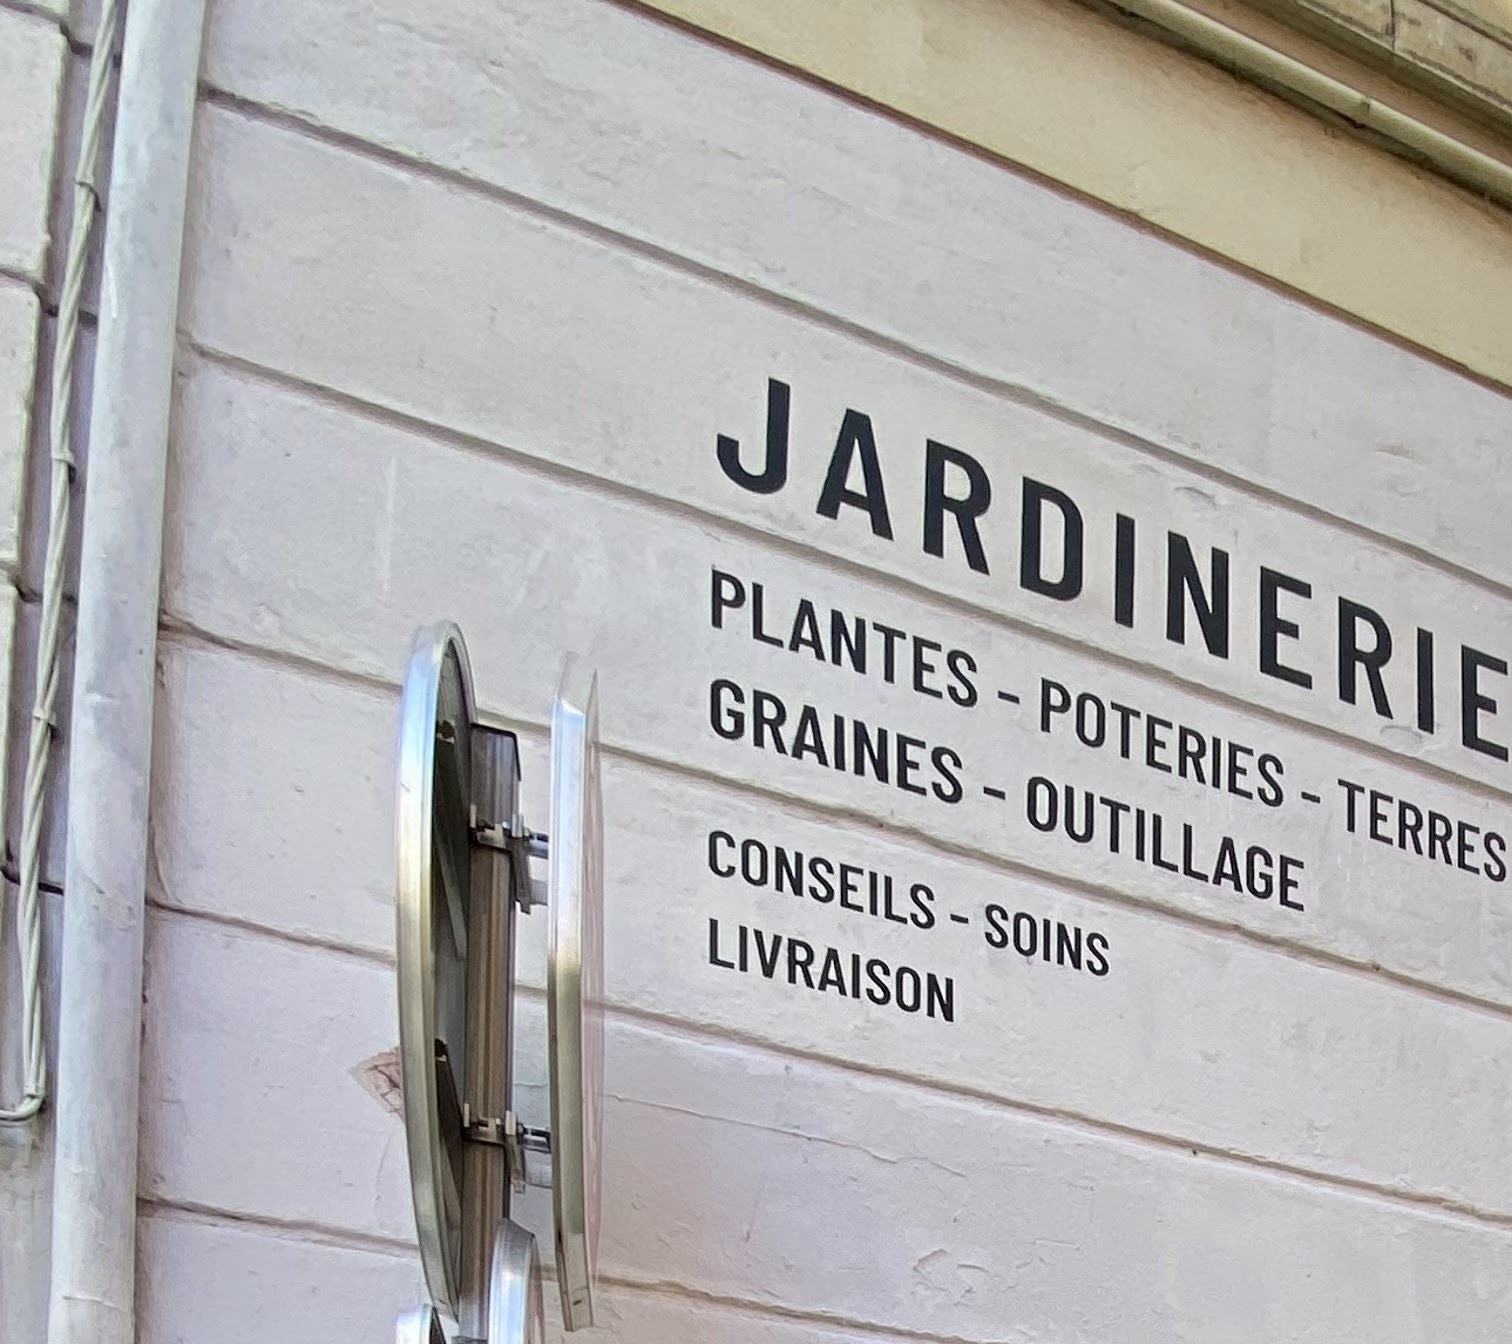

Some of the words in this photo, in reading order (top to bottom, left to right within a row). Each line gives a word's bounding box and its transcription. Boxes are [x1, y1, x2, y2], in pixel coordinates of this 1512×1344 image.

[715, 376, 1510, 763] JARDINERIE
[709, 679, 964, 804] GRAINES
[1025, 775, 1306, 912] OUTILLAGE
[711, 567, 979, 708] PLANTES
[1039, 676, 1285, 808] POTERIES
[1337, 778, 1508, 882] TERRES
[707, 829, 936, 930] CONSEILS
[984, 903, 1110, 977] SOINS
[708, 917, 955, 1023] LIVRAISON
